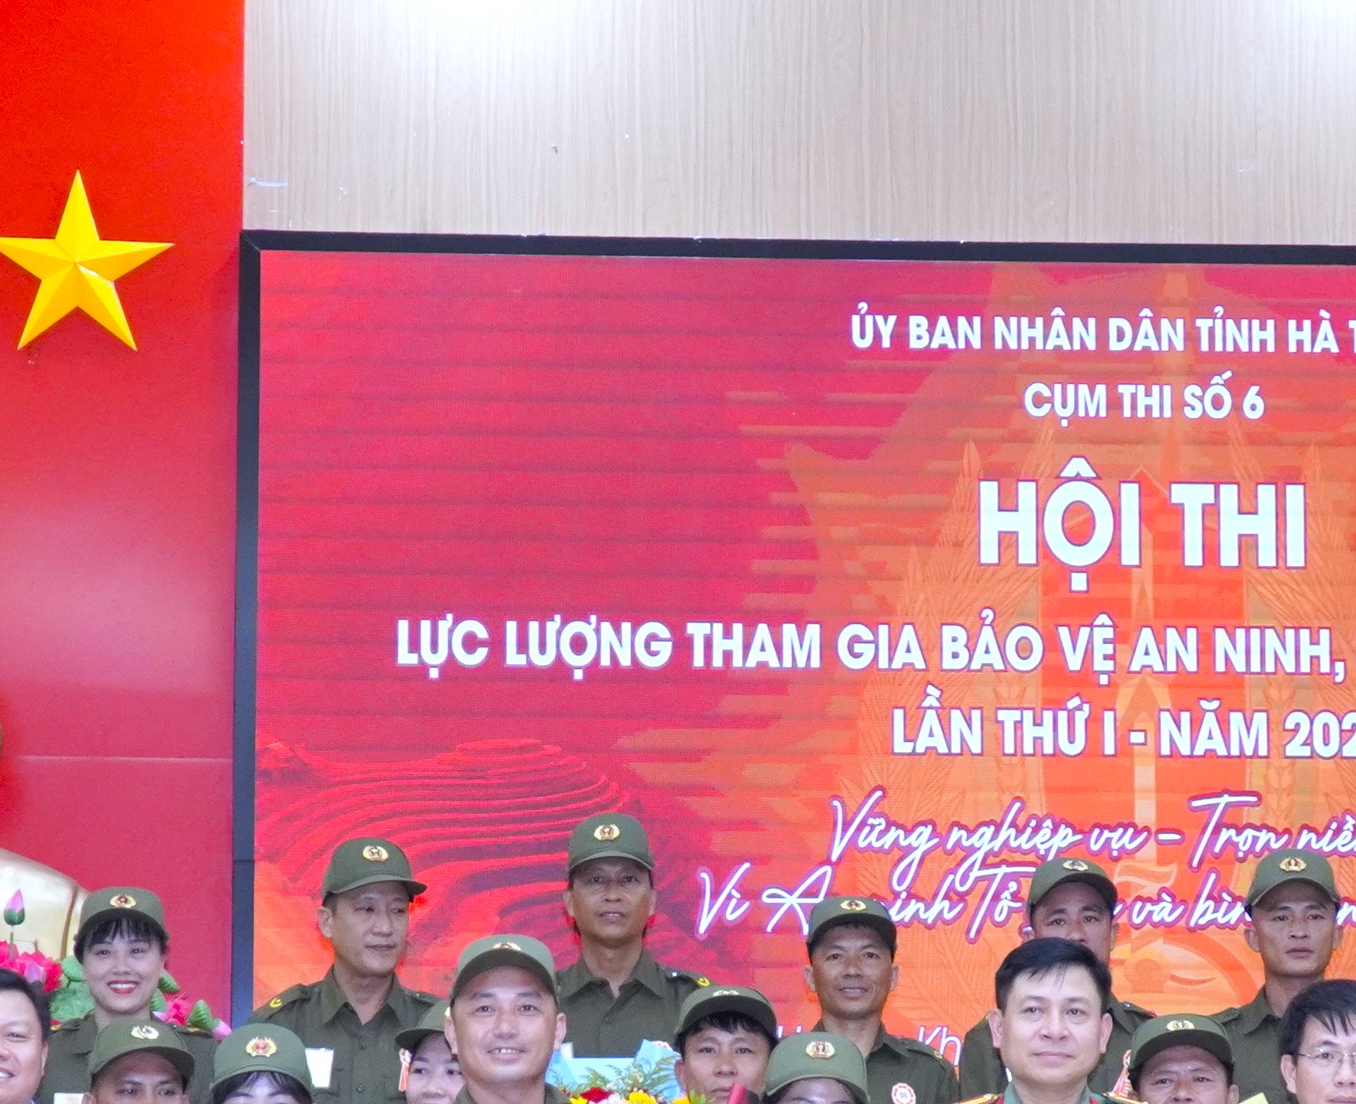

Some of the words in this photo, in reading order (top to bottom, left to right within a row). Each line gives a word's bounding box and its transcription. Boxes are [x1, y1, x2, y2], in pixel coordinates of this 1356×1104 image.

[851, 302, 898, 349] ỦY
[909, 315, 982, 350] BAN
[994, 307, 1097, 351] NHÂN
[1108, 308, 1185, 352] DÂN
[1195, 305, 1275, 353] TỈNH
[1288, 309, 1340, 353] HÀ
[1024, 382, 1107, 427] CỤM
[1117, 384, 1172, 418] THI
[1183, 370, 1233, 419] SỐ
[1242, 385, 1265, 420] 6
[979, 457, 1141, 592] HỘI
[1170, 482, 1307, 568] THI
[397, 613, 489, 679] LỰC
[506, 614, 673, 680] LƯỢNG
[686, 622, 821, 669] THAM
[837, 623, 926, 671] GIA
[942, 608, 1044, 672] BẢO
[1057, 614, 1117, 685] VỆ
[1129, 627, 1199, 673] AN
[1215, 628, 1346, 683] NINH,
[893, 684, 983, 755] LẦN
[998, 697, 1090, 756] THỨ
[1102, 709, 1116, 756] I
[1130, 731, 1146, 745] -
[1160, 700, 1269, 757] NĂM
[831, 790, 938, 891] Vững
[947, 802, 1082, 891] nghiệp
[1089, 825, 1147, 856] vụ
[1191, 795, 1287, 868] Trọn
[699, 862, 750, 934] Vì
[1132, 887, 1188, 926] và
